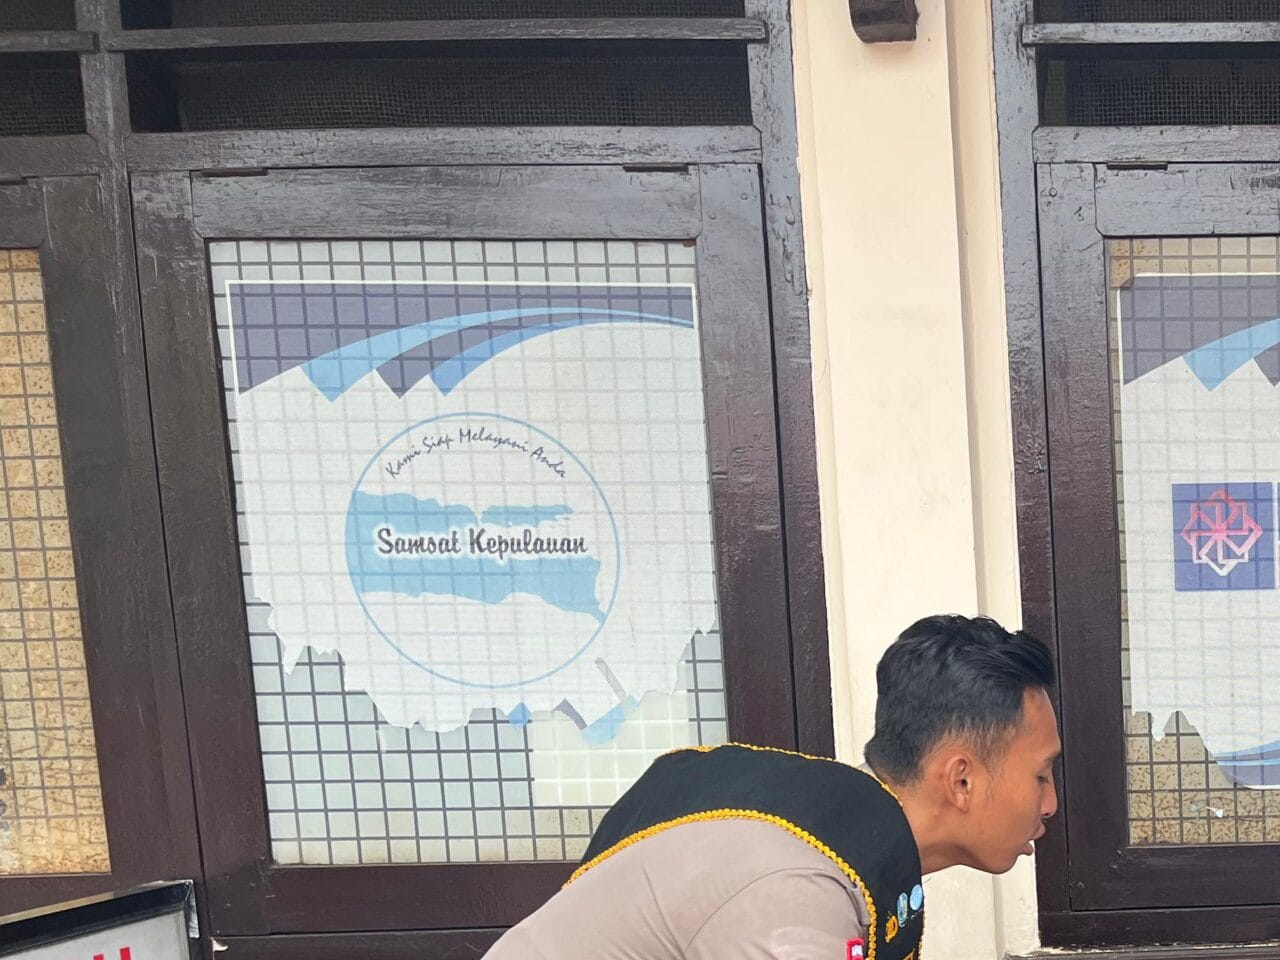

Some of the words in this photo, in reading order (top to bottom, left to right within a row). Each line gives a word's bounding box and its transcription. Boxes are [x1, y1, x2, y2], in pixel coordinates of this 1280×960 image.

[385, 445, 421, 479] Kami
[422, 434, 455, 454] Siap
[459, 427, 529, 453] Melayani
[531, 446, 567, 478] Anda
[377, 527, 462, 555] Samsat
[468, 527, 589, 560] Kepulauan
